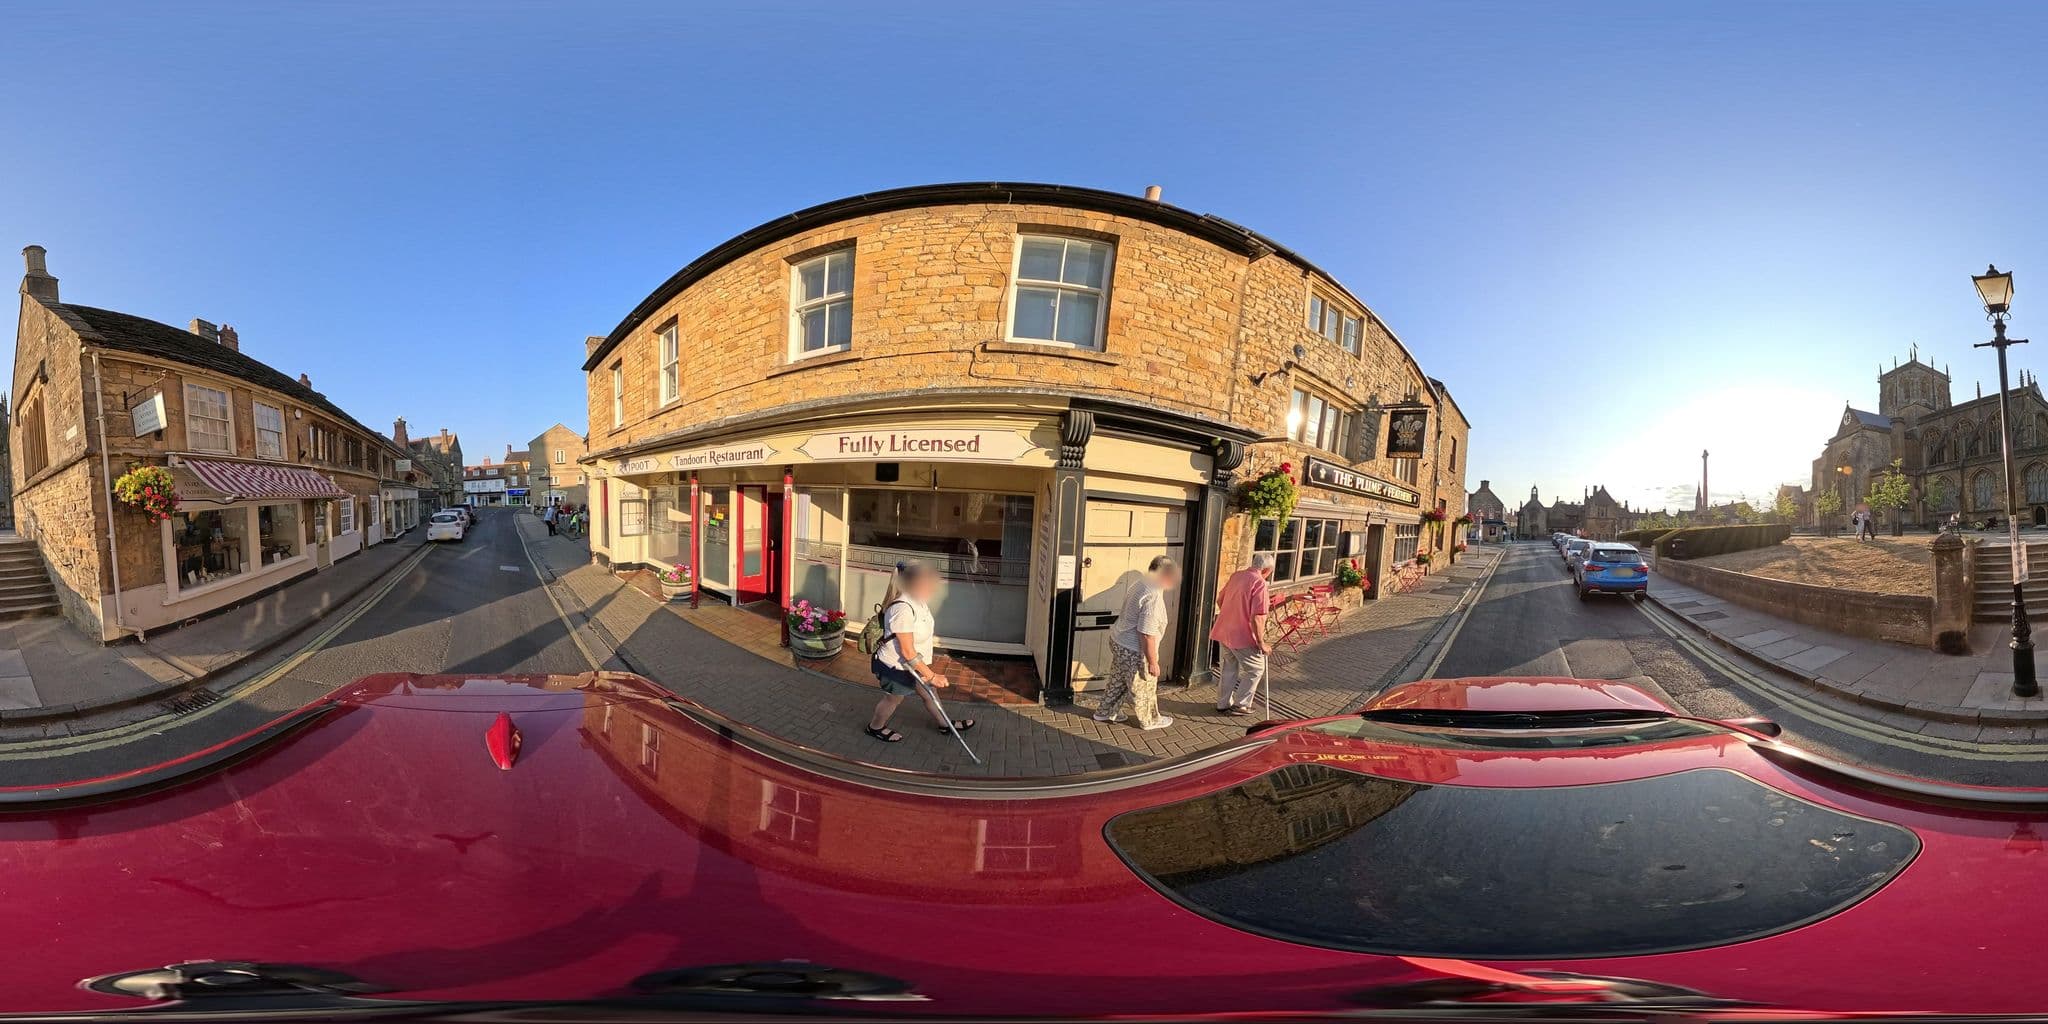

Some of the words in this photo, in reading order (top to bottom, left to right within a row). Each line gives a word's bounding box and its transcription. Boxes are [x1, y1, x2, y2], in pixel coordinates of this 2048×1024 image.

[839, 435, 884, 456] Fully
[889, 434, 980, 453] Licensed
[674, 453, 707, 467] Tandoori
[709, 447, 764, 465] Restaurant
[1333, 469, 1354, 488] THE
[1355, 477, 1383, 494] PLUME
